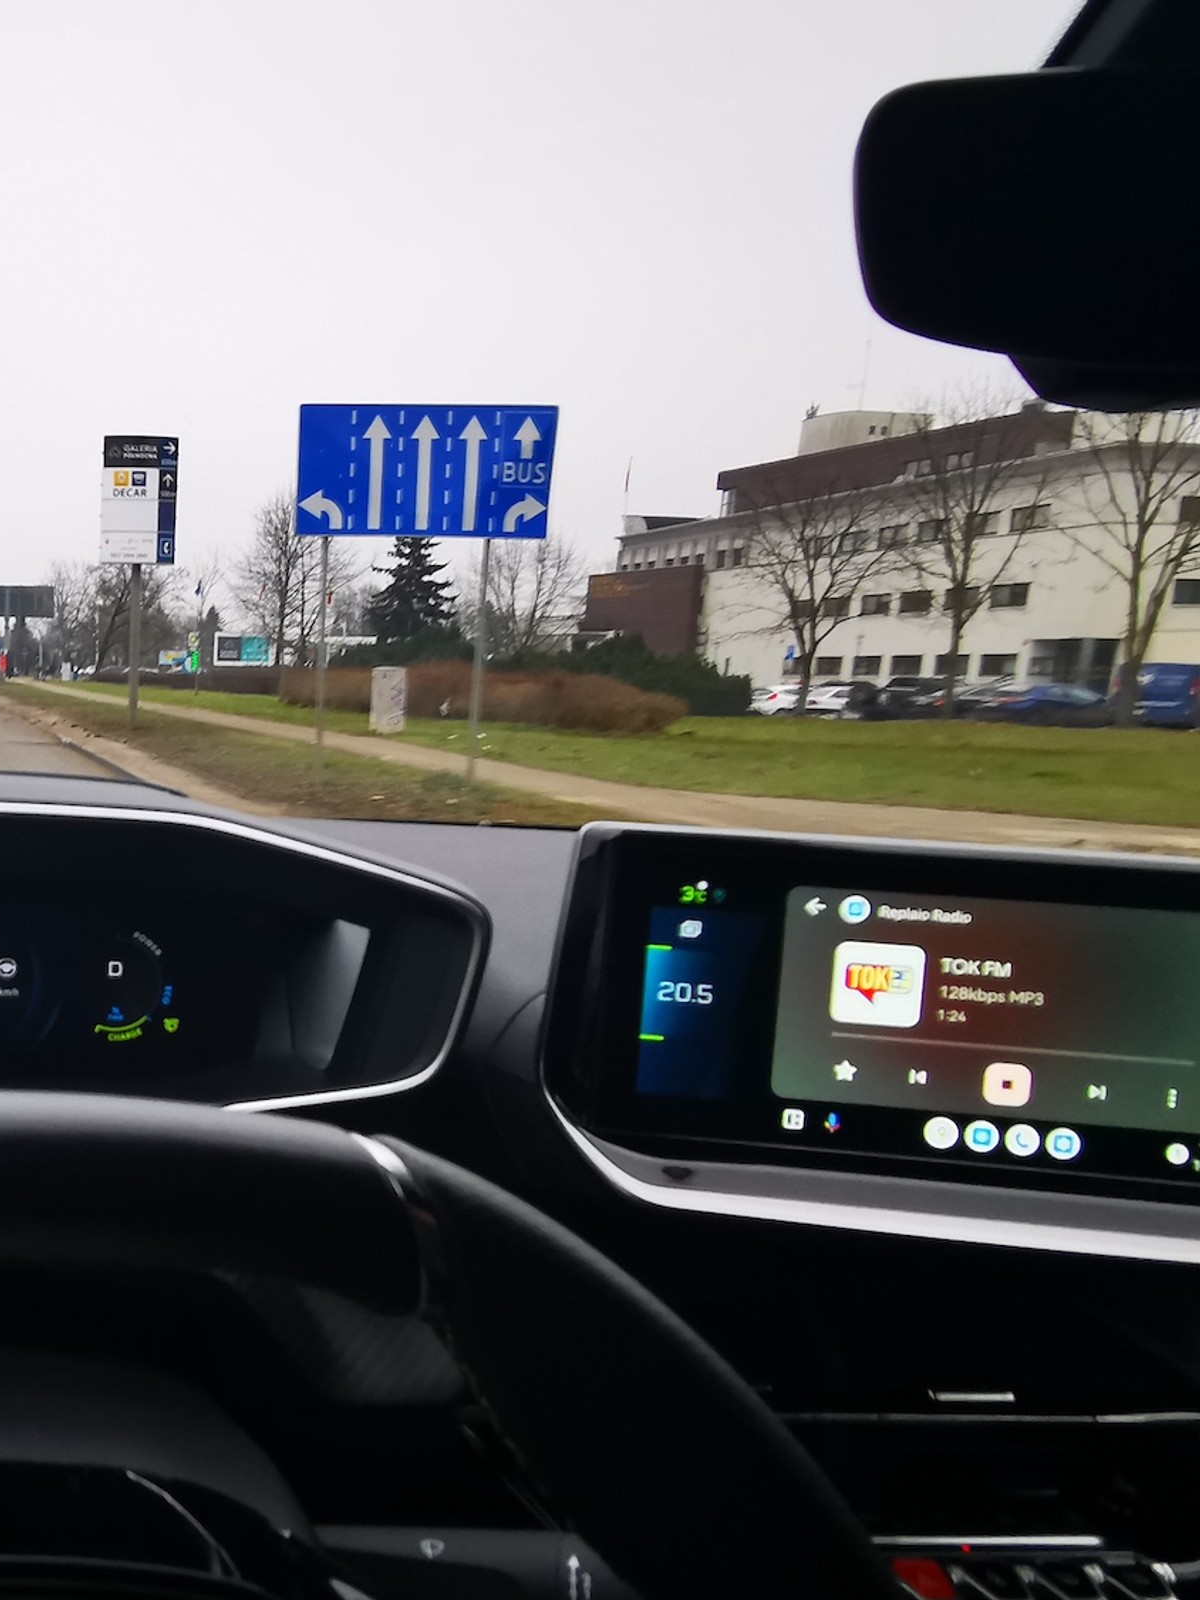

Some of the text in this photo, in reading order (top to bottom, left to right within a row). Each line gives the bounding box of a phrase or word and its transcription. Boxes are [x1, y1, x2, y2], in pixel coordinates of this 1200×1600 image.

[122, 443, 158, 453] GALERIA
[502, 461, 546, 484] BUS
[112, 488, 148, 498] DECAR
[878, 904, 973, 925] Replaio Radio
[132, 931, 162, 956] POWER
[108, 960, 123, 977] D
[848, 964, 892, 991] TOK
[940, 957, 1013, 978] TOK FM
[657, 980, 714, 1005] 20.5
[939, 985, 1045, 1006] 128kbps MP3
[936, 1009, 967, 1023] 1:24
[107, 1027, 143, 1042] CHARGE
